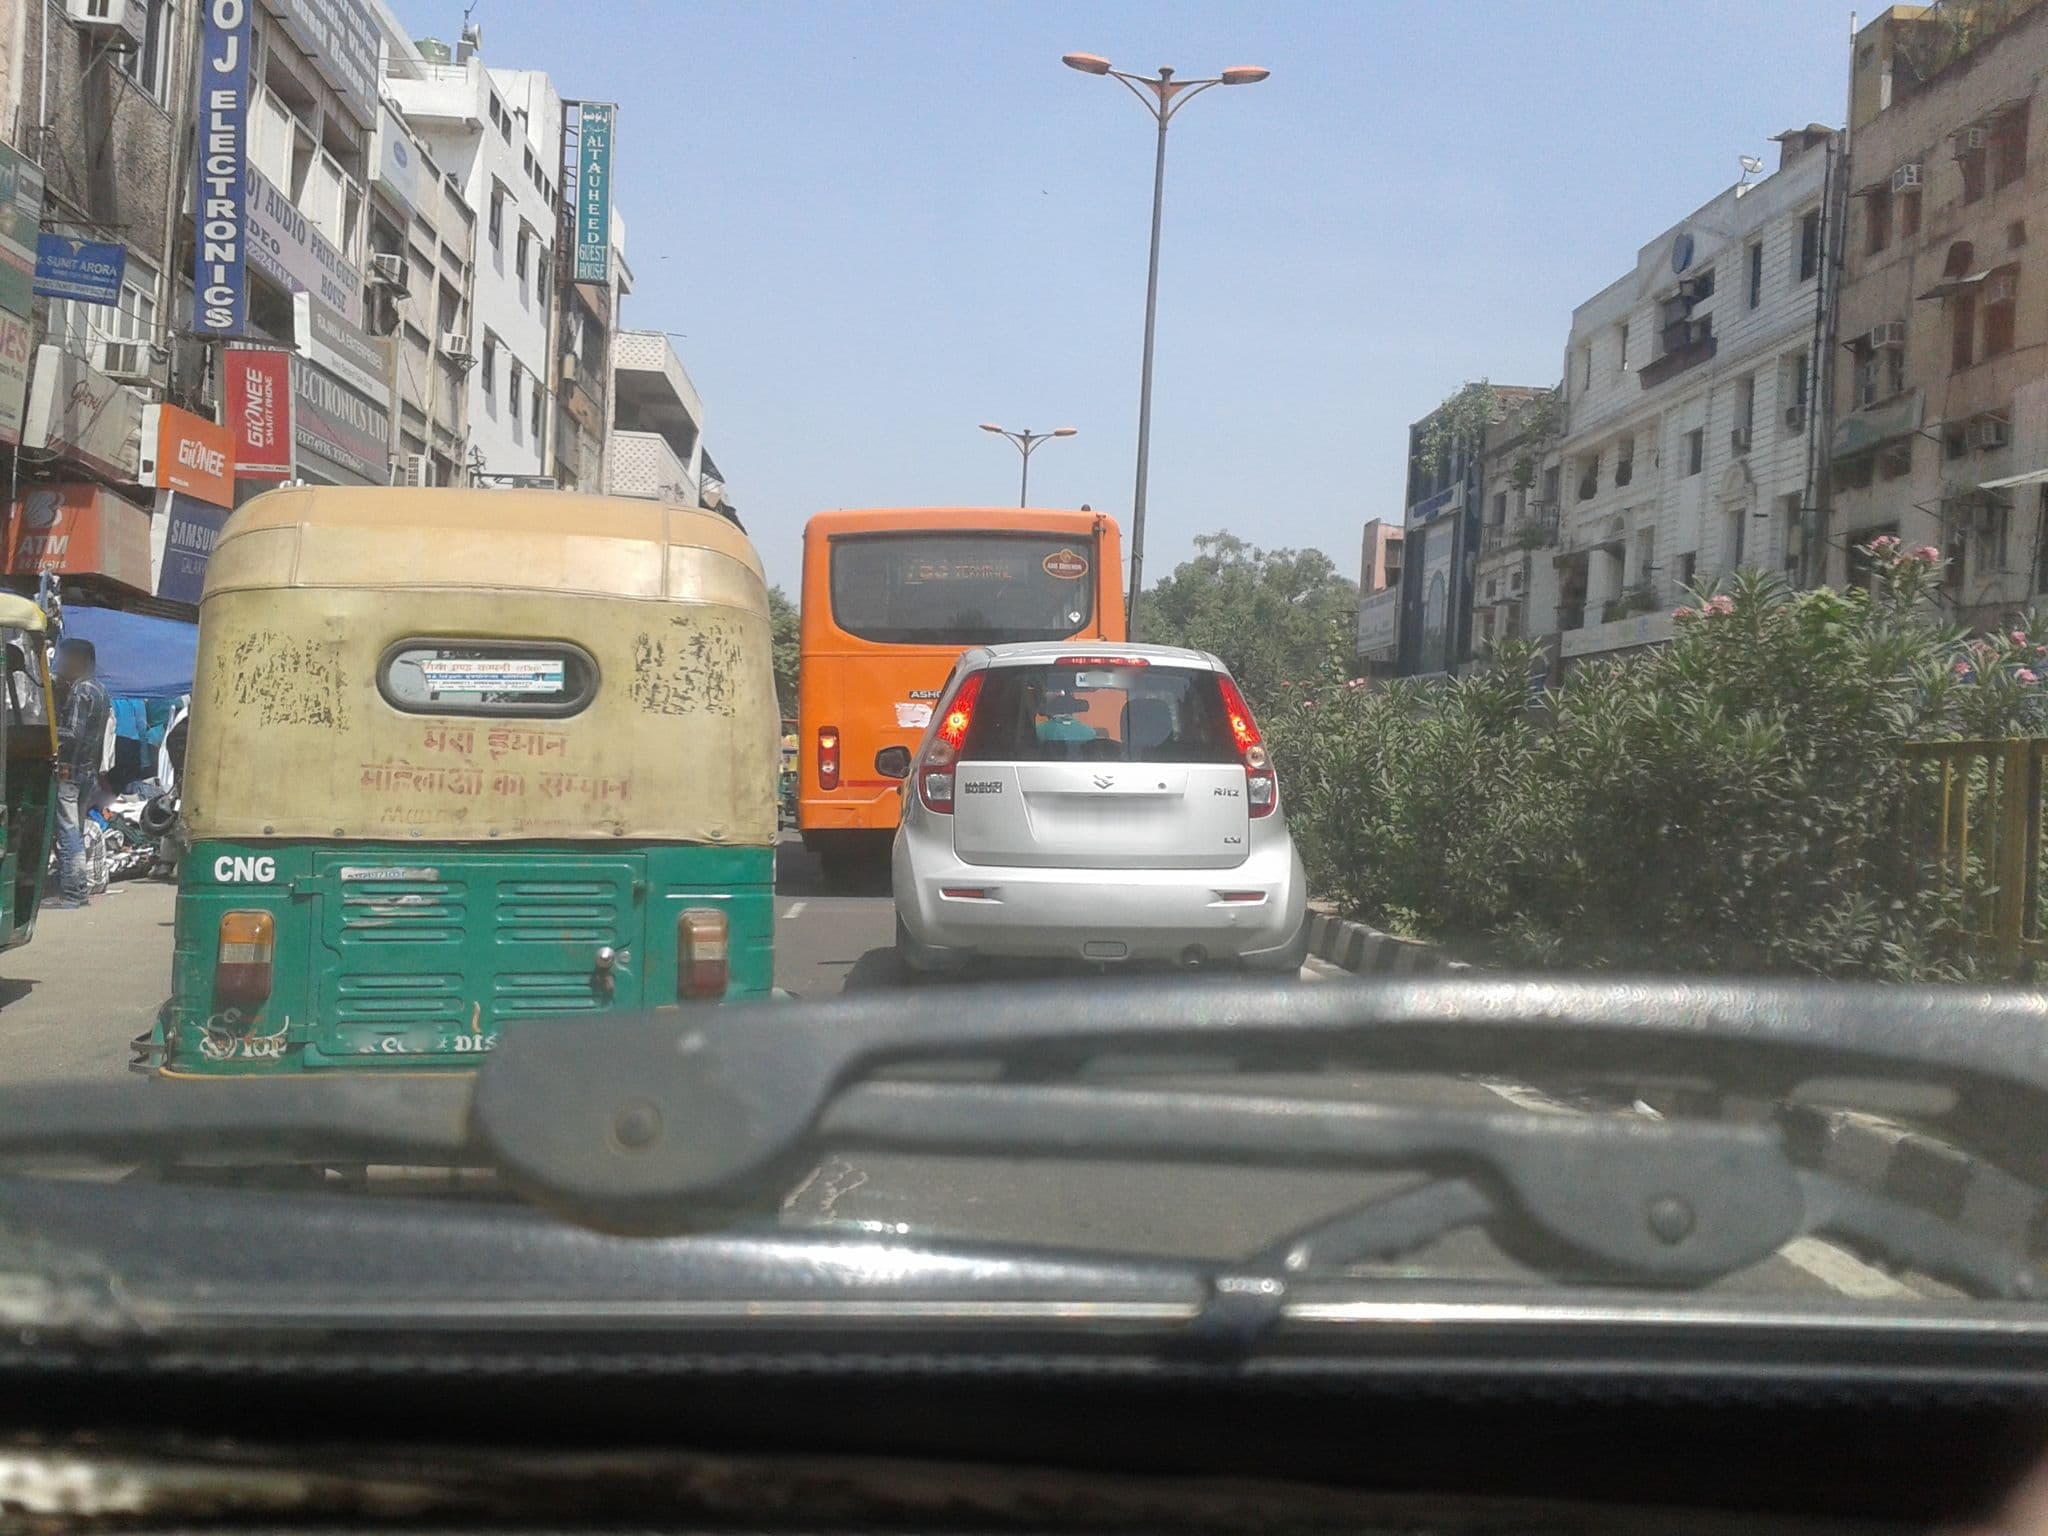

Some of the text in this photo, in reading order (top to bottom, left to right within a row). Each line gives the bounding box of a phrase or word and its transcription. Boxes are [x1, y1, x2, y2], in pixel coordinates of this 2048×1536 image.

[587, 135, 605, 148] AL
[203, 90, 238, 328] ELECTRONICS
[587, 148, 602, 243] TAUHEED
[265, 186, 306, 247] AUDIO
[310, 231, 359, 297] PRIYA GUEST
[579, 244, 606, 261] GUEST
[79, 261, 117, 277] ARORA
[578, 262, 605, 280] HOUSE
[321, 273, 347, 314] HOUSE
[264, 375, 275, 446] SMART PHONE
[19, 535, 70, 556] ATM
[492, 768, 526, 797] का
[214, 856, 276, 883] CNG
